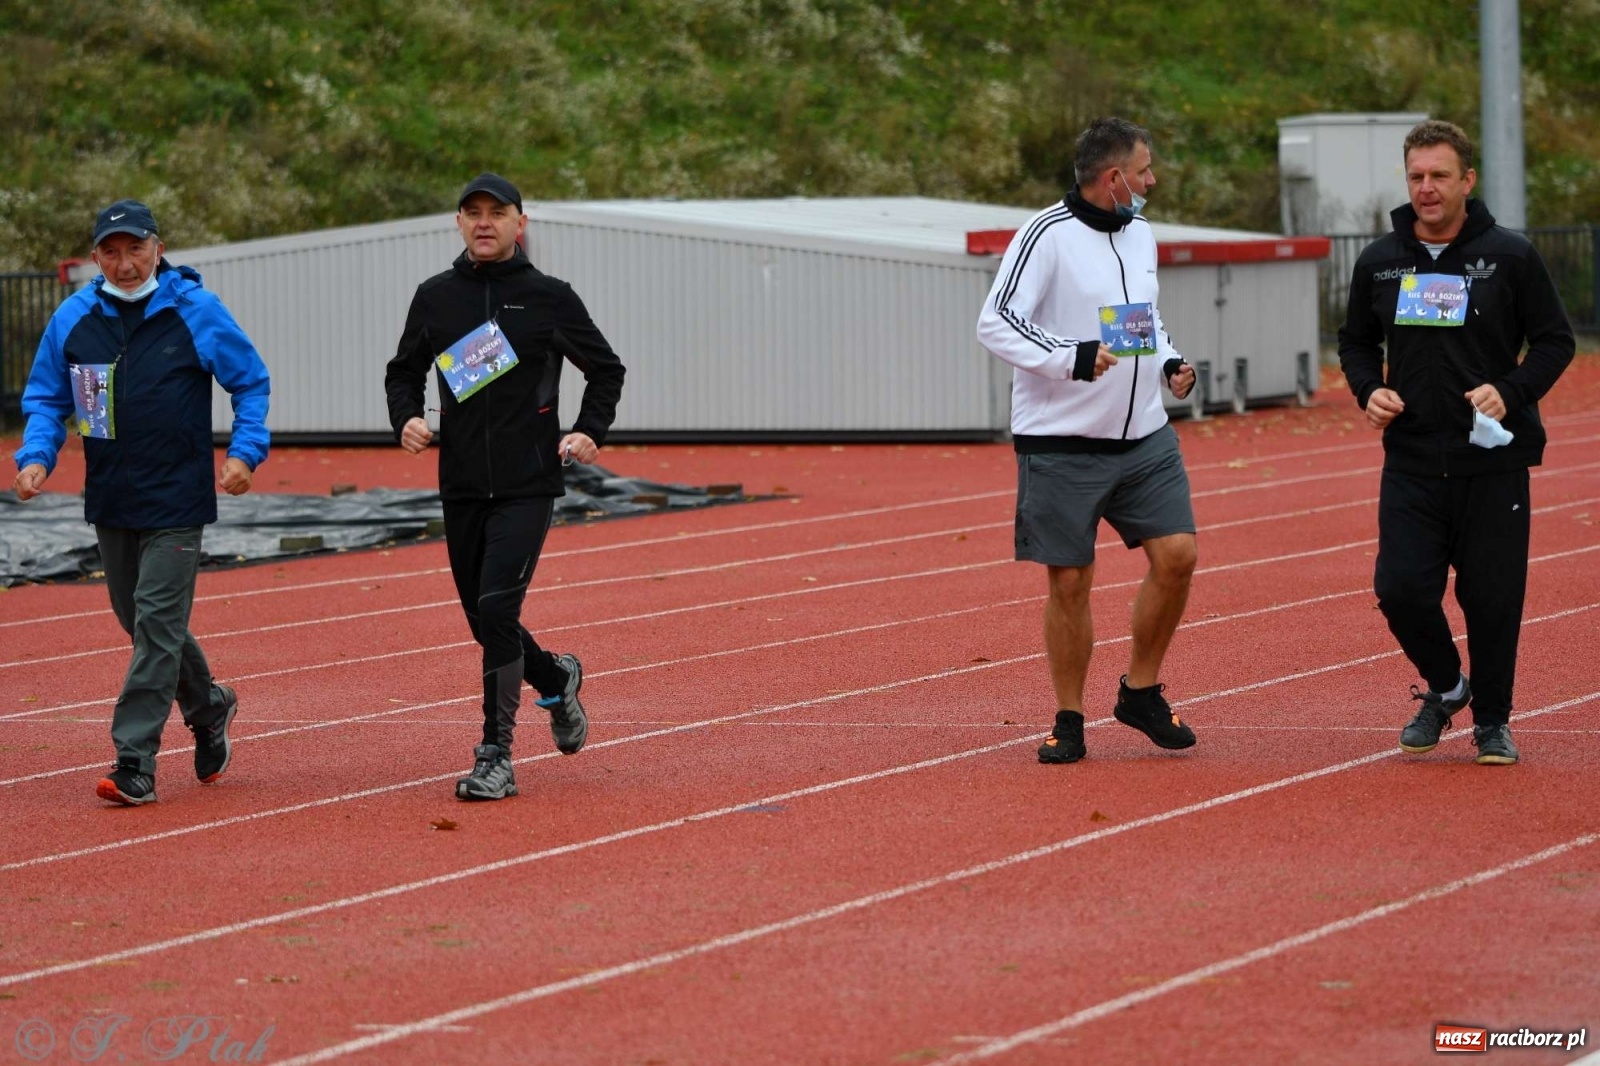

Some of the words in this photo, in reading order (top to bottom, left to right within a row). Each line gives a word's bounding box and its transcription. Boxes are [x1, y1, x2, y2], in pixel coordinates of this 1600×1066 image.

[1373, 267, 1414, 281] adidas
[1423, 291, 1436, 299] DLA
[1436, 307, 1460, 319] 146
[465, 353, 478, 365] DLA
[98, 371, 107, 394] 325
